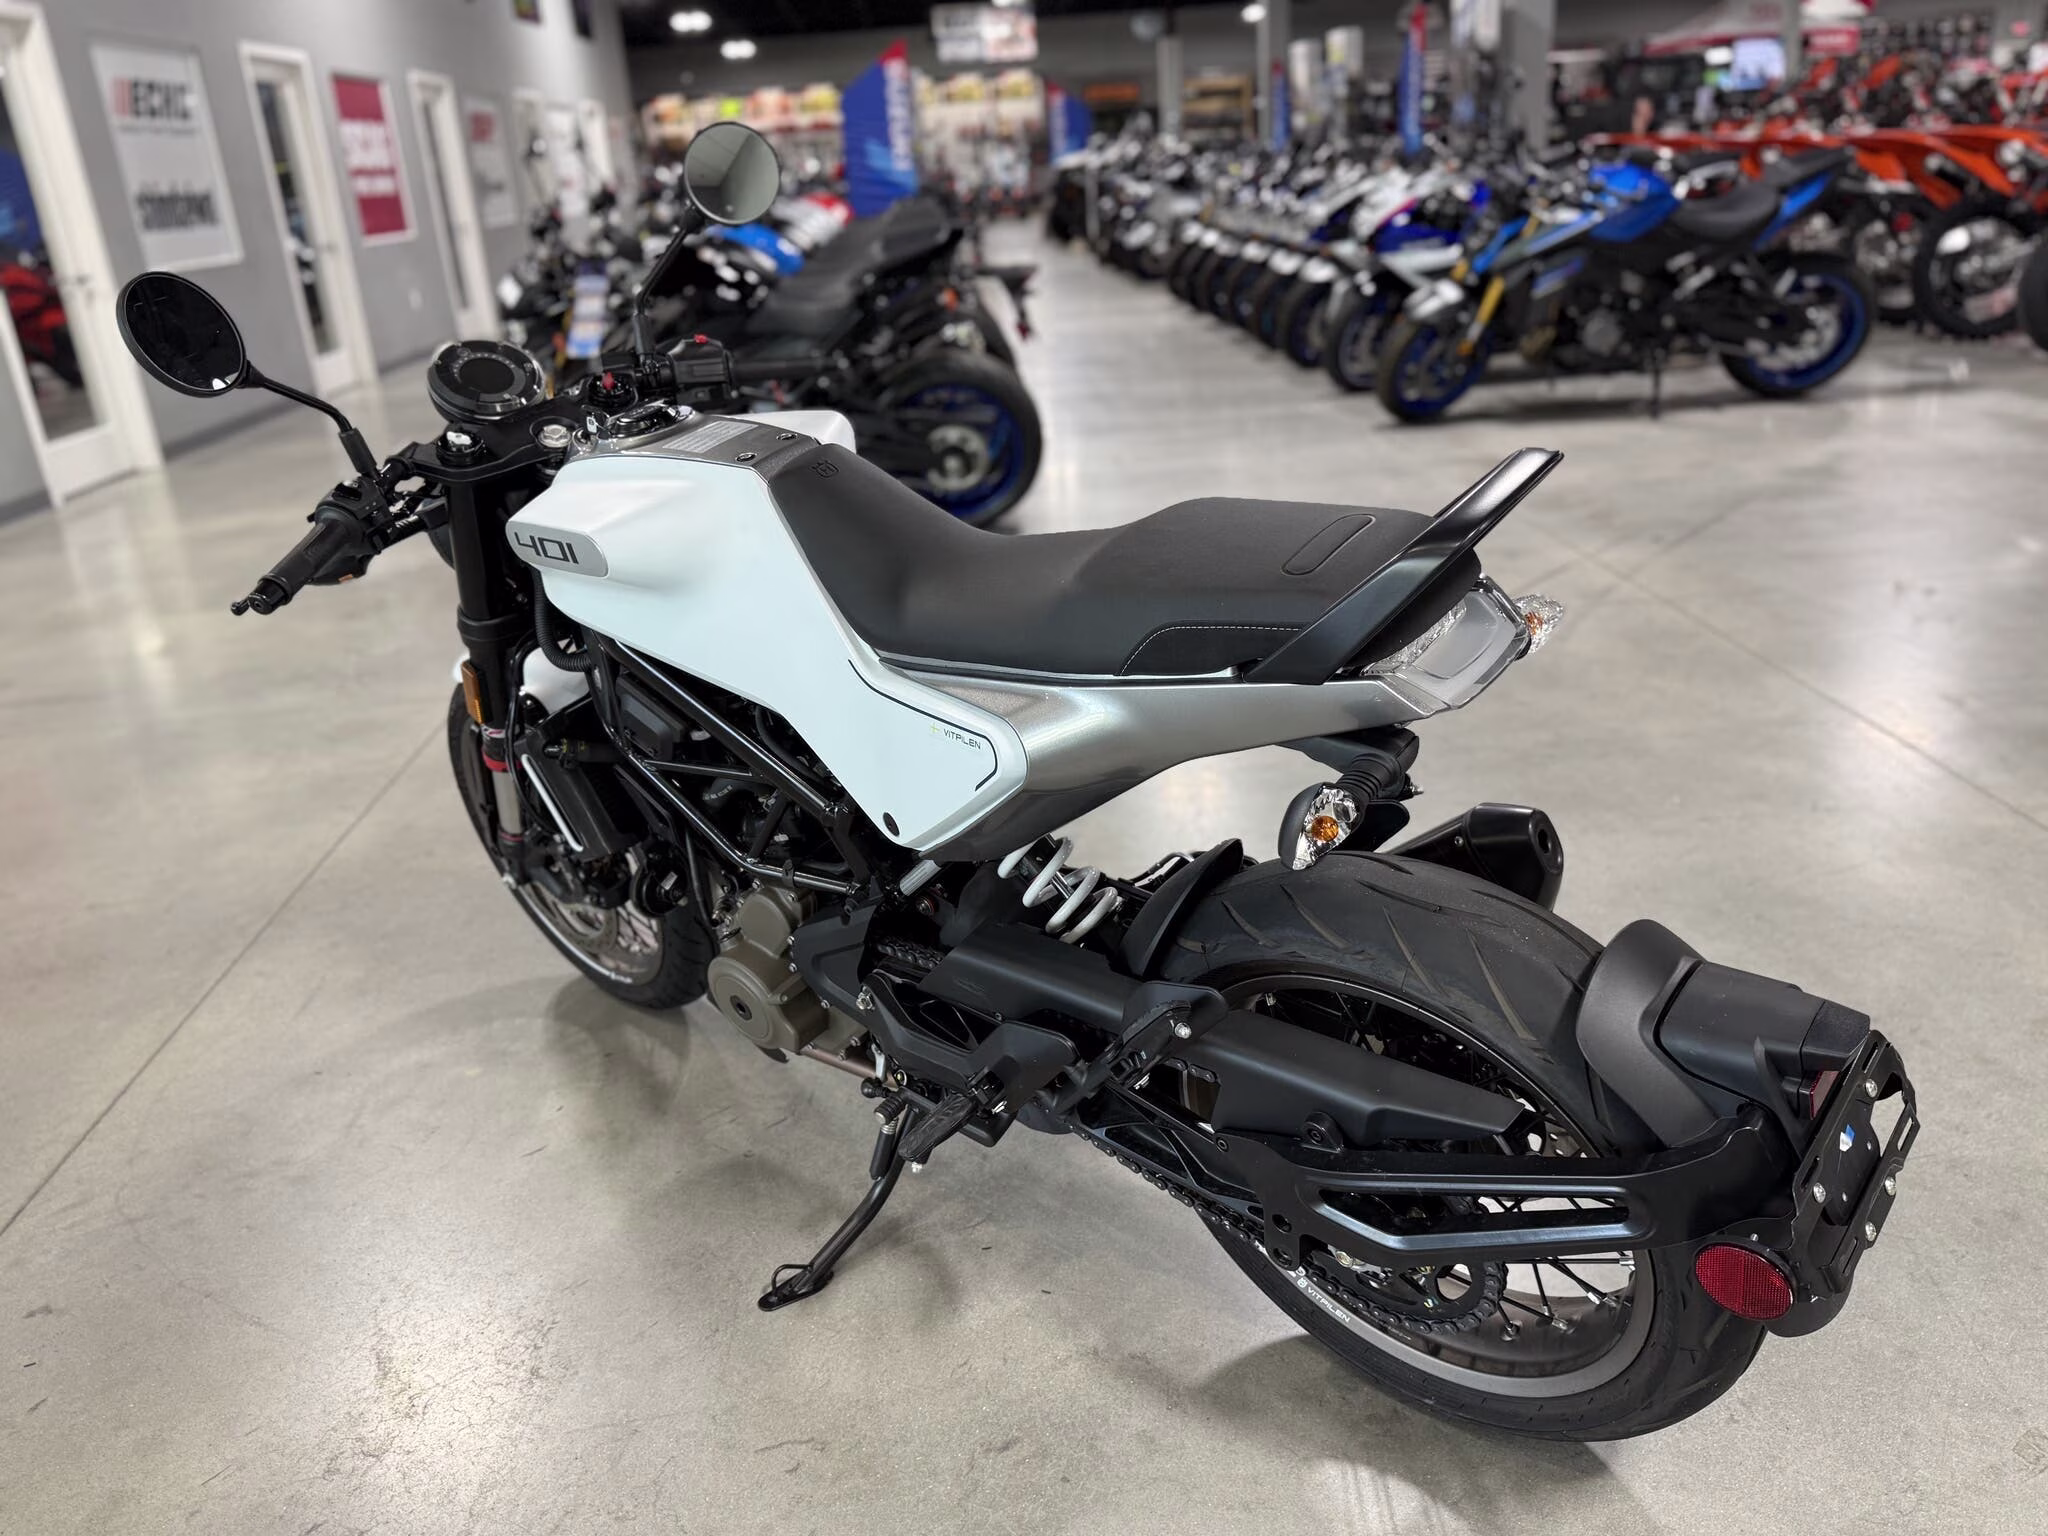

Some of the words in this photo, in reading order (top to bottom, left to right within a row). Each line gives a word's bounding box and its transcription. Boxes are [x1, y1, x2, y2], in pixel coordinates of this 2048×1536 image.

[514, 531, 579, 565] 401
[943, 728, 981, 750] VITPILEN
[1307, 1286, 1351, 1323] VITPILEN
